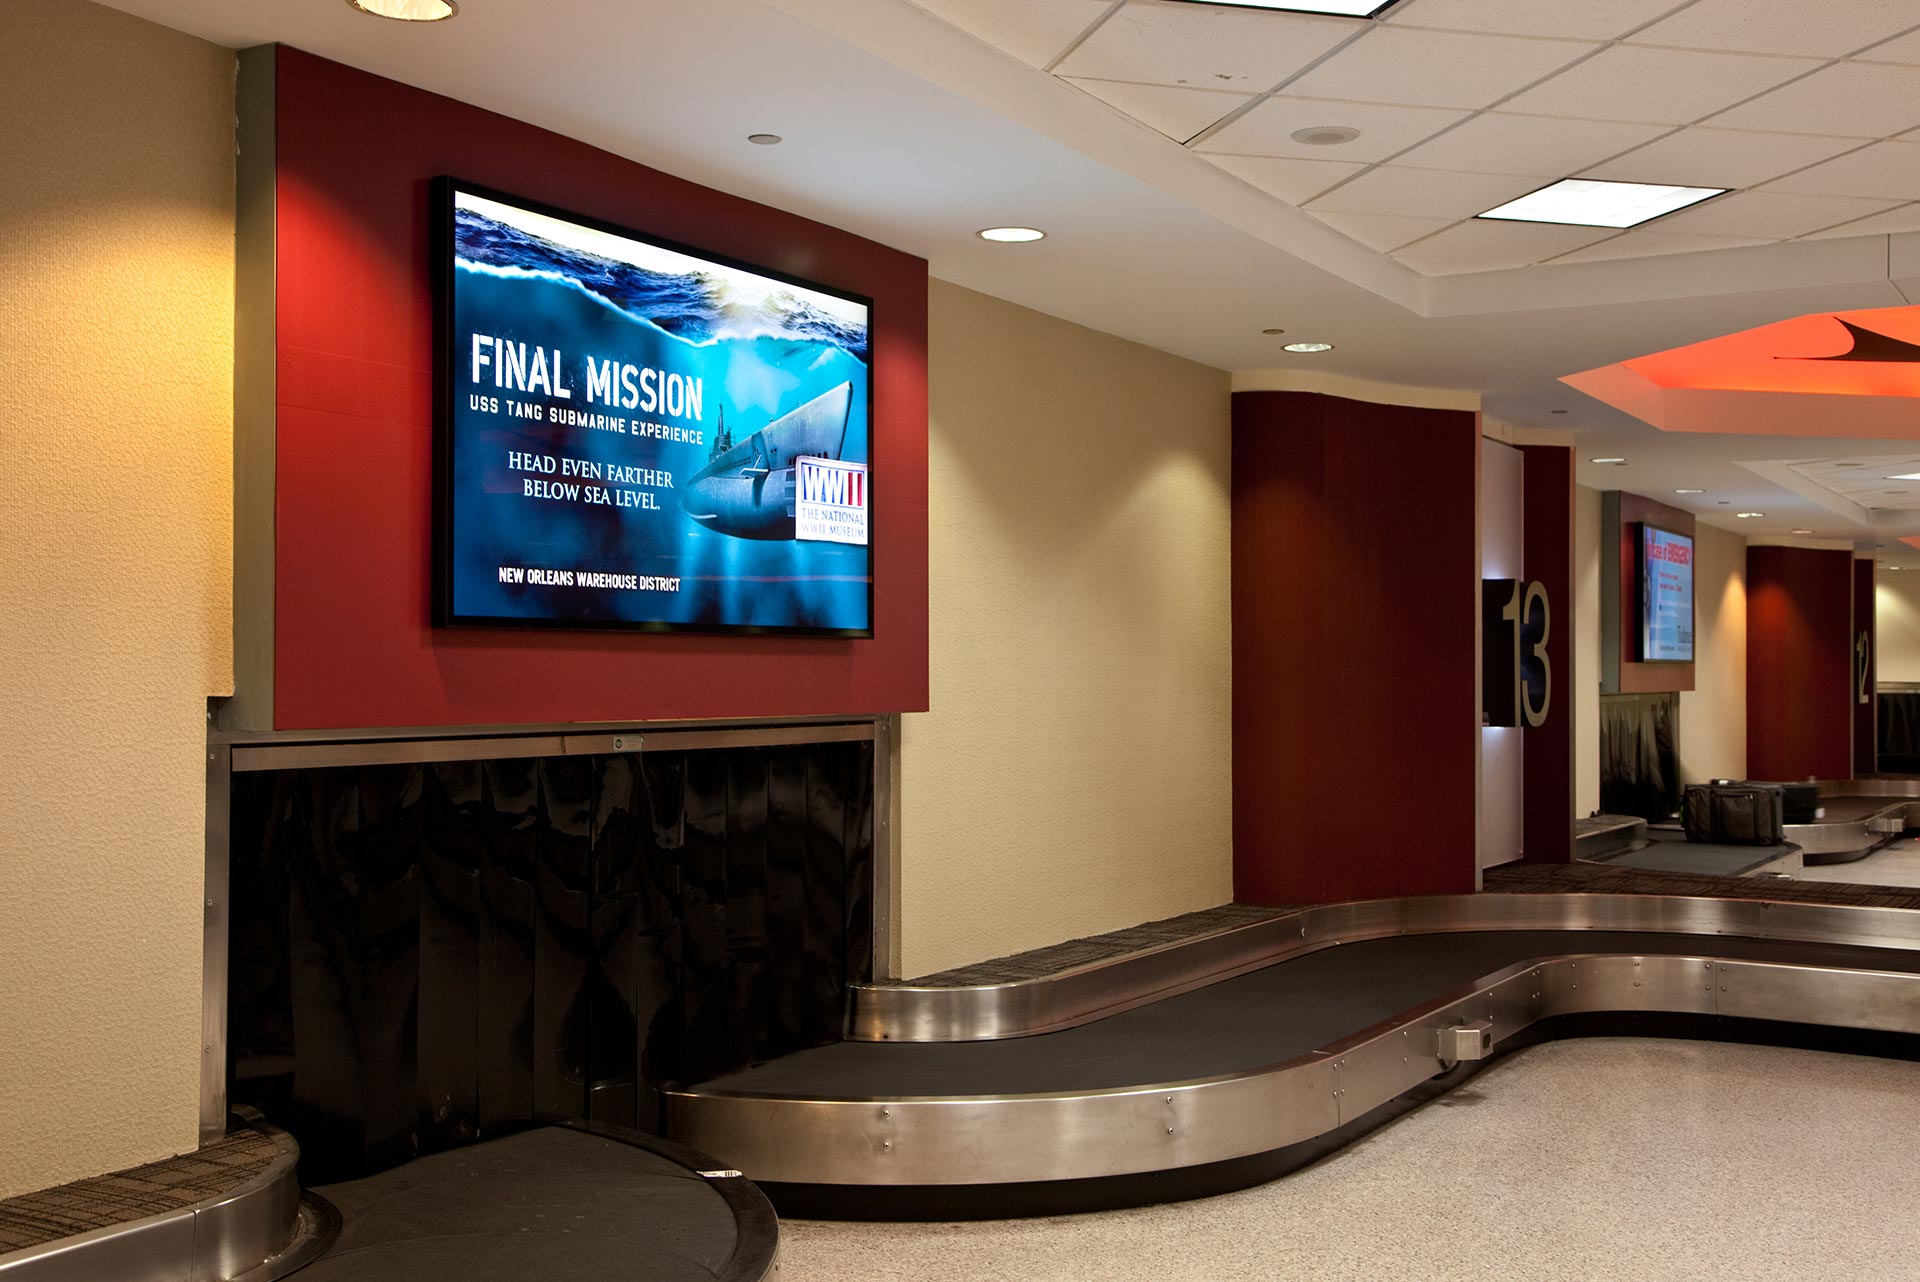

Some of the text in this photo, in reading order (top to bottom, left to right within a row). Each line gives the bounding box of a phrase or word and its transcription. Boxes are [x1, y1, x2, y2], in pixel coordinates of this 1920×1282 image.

[472, 333, 703, 421] FINAL MISSION
[469, 394, 704, 445] USS TANG SUBMARINE EXPERIENCE
[508, 451, 675, 488] HEAD EVEN FARTHER
[523, 478, 661, 510] BELOW SEA LEVEL.
[801, 522, 865, 538] WWII MUSEUM
[802, 507, 865, 526] THE NATIONAL
[498, 567, 681, 592] NEW ORLEANS WAREHOUSE DISTRICT
[1502, 578, 1552, 728] 13
[1856, 630, 1870, 704] 12
